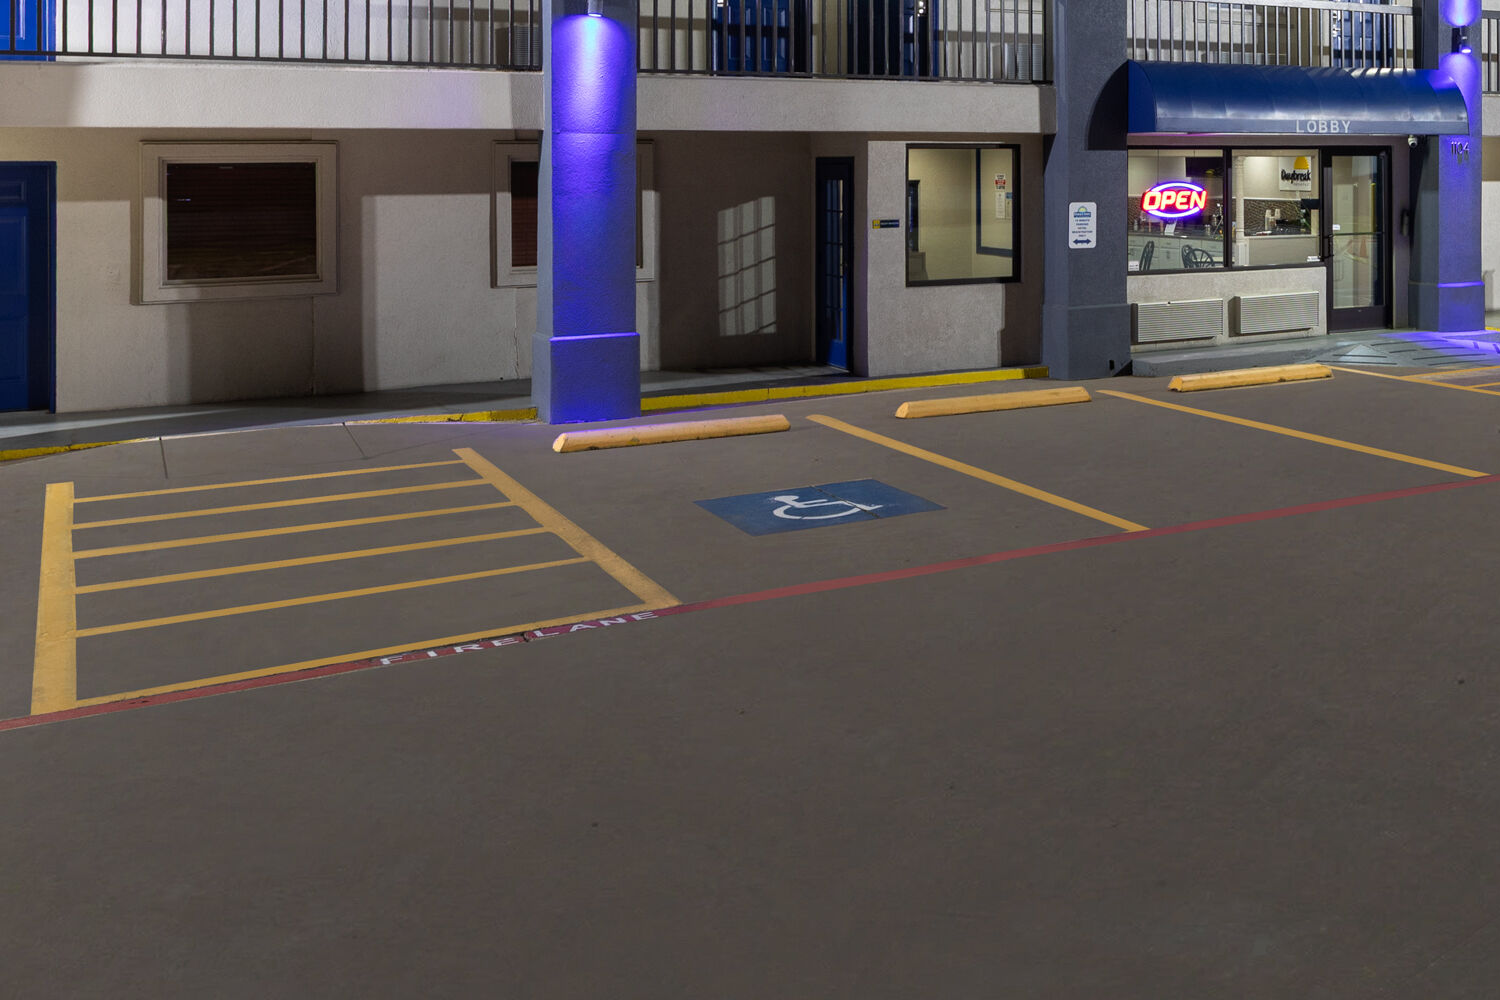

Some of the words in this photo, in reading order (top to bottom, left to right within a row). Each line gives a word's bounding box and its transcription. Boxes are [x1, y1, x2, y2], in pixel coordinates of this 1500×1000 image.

[1296, 120, 1351, 133] LOBBY
[1451, 141, 1470, 156] 1104
[1142, 190, 1207, 211] OPEN
[380, 637, 519, 665] FIRE
[534, 611, 658, 638] LANE
